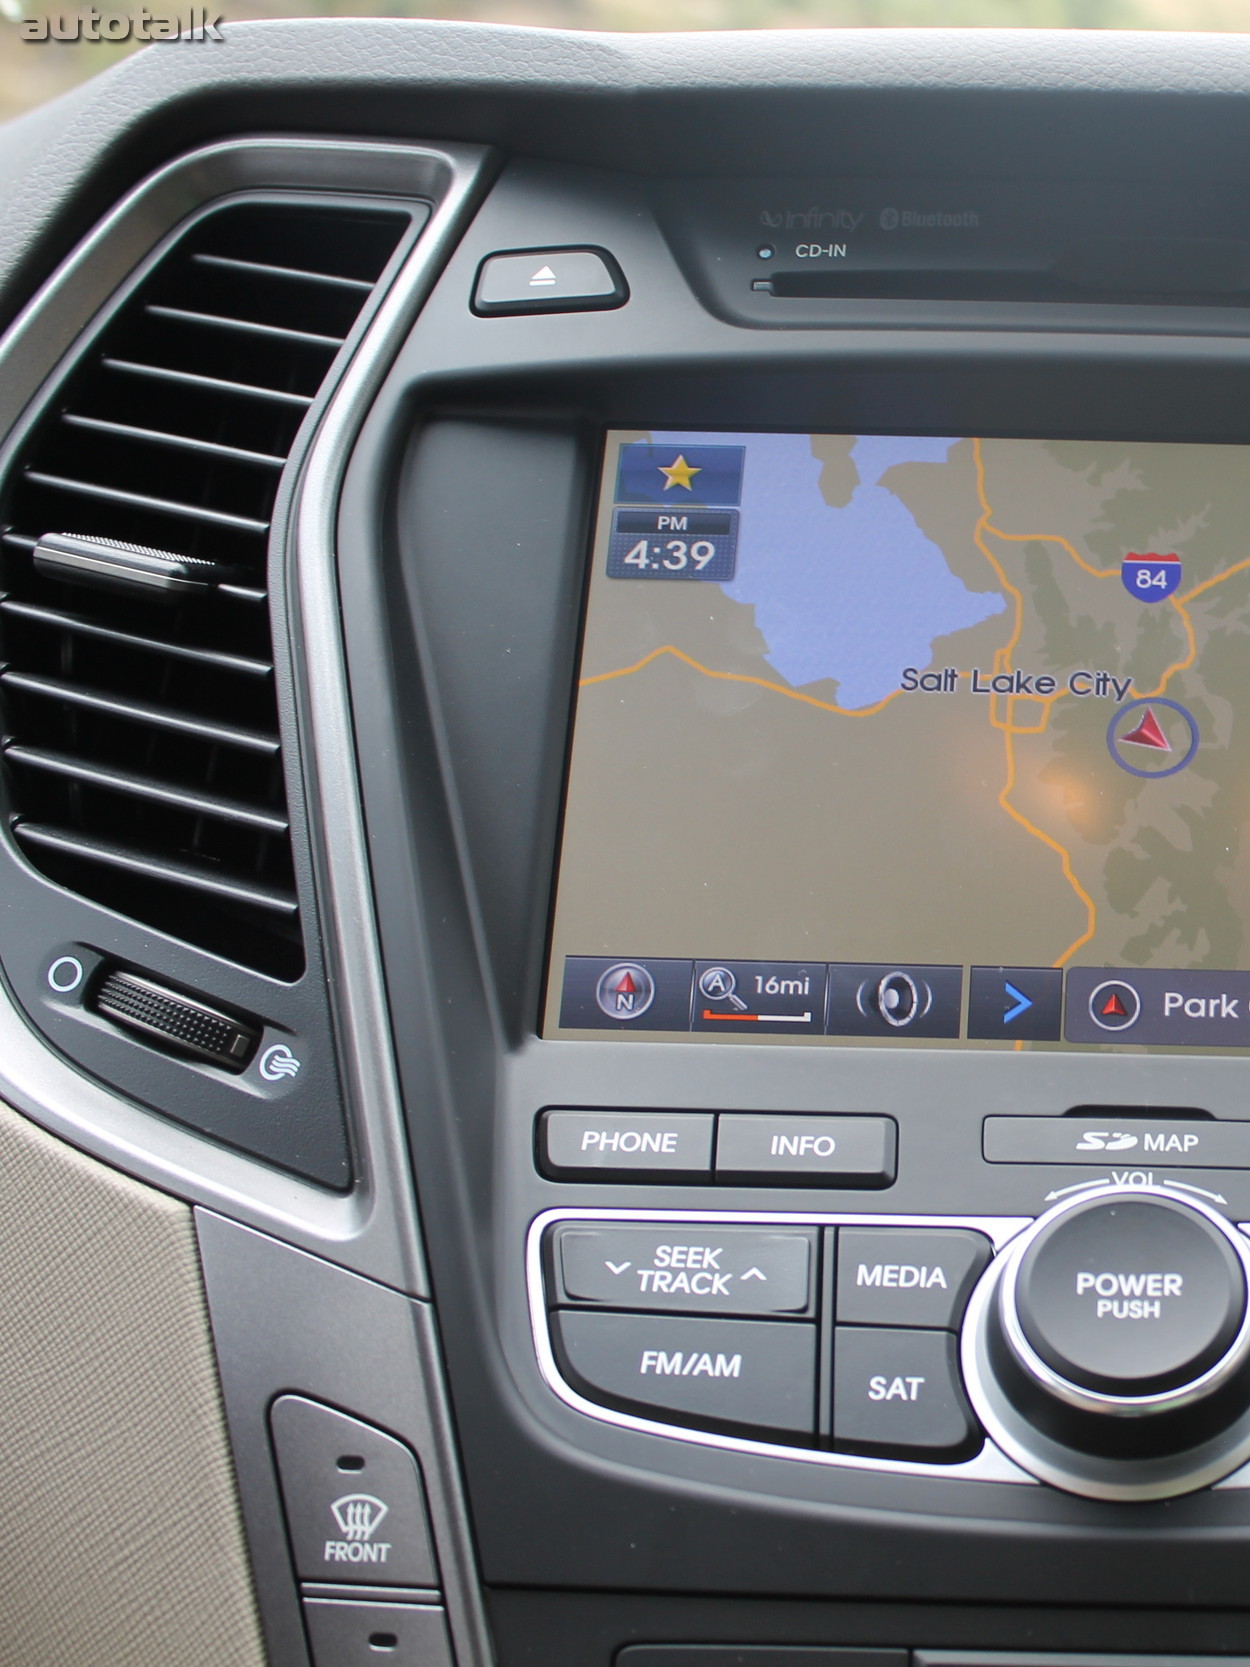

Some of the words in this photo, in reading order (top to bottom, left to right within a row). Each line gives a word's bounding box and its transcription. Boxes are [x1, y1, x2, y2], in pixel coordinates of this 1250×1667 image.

[902, 210, 979, 228] Bluetooth
[794, 243, 848, 259] CD-IN
[656, 515, 689, 532] PM
[622, 540, 716, 571] 4:39
[1135, 568, 1169, 591] 84
[900, 667, 959, 694] Salt
[970, 668, 1056, 696] Lake
[1067, 670, 1132, 702] City
[754, 975, 810, 996] 16mi
[615, 993, 634, 1012] N
[1162, 992, 1238, 1020] Park
[580, 1131, 678, 1153] PHONE
[770, 1135, 836, 1157] INFO
[1143, 1133, 1199, 1153] MAP
[1111, 1171, 1160, 1187] VOL
[654, 1245, 724, 1270] SEEK
[637, 1269, 732, 1296] TRACK
[856, 1264, 948, 1289] MEDIA
[1076, 1272, 1183, 1299] POWER
[1096, 1298, 1161, 1320] PUSH
[639, 1350, 742, 1379] FM/AM
[868, 1376, 925, 1401] SAT
[324, 1540, 391, 1563] FRONT
